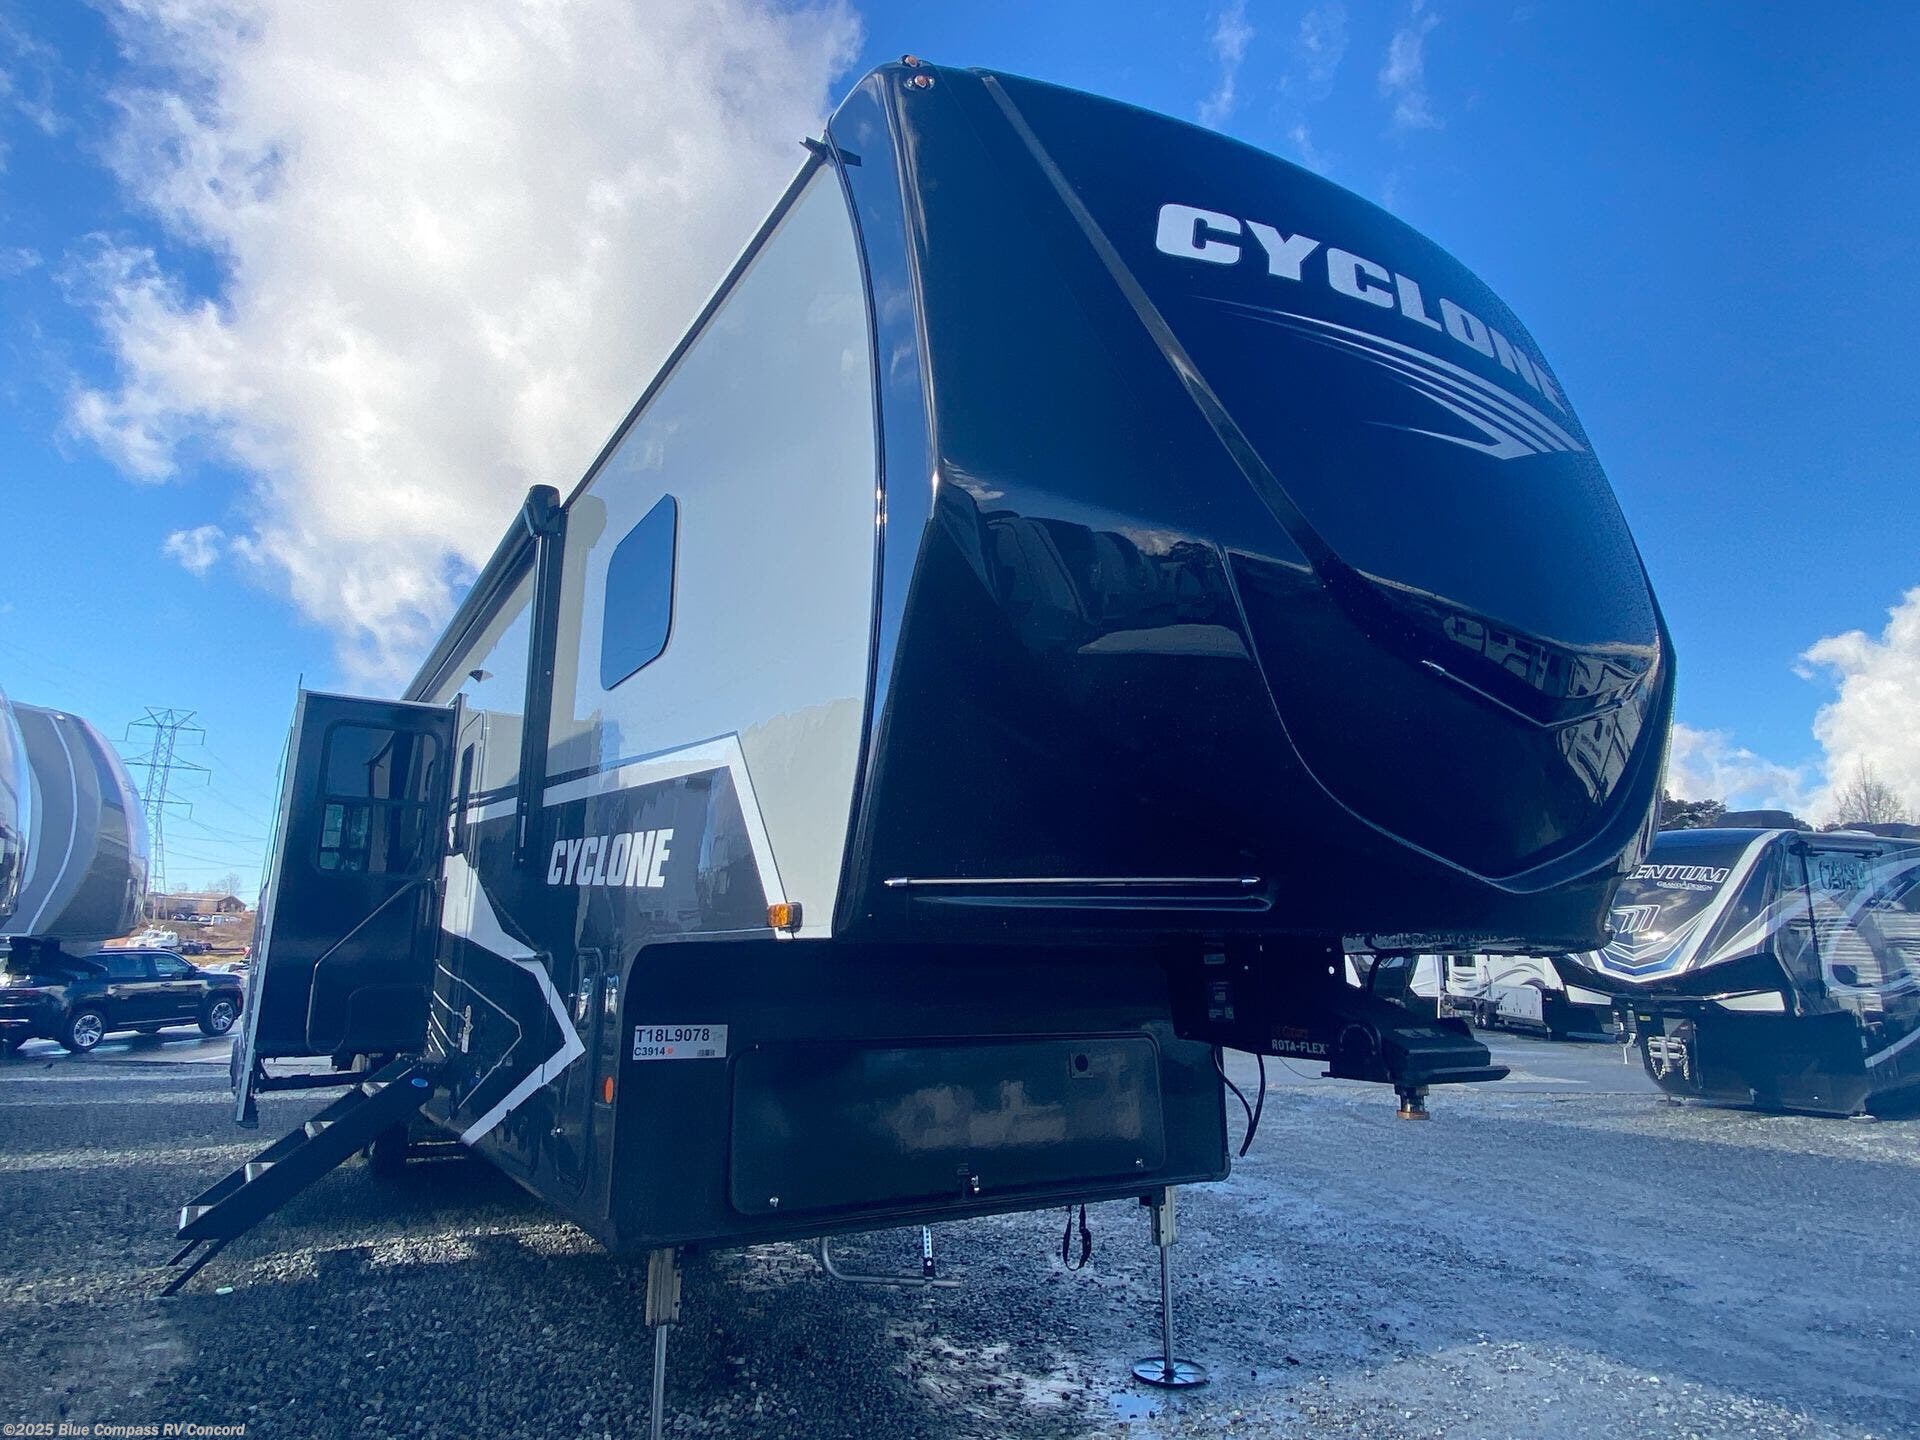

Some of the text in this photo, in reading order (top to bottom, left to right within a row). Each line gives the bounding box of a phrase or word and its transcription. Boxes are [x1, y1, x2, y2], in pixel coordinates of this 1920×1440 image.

[1156, 203, 1567, 417] CYCLONE
[547, 828, 674, 888] CYCLONE
[1627, 864, 1730, 883] ENTUM
[1656, 881, 1713, 891] GRAND DESIGN
[636, 1028, 710, 1042] T18L9078
[634, 1047, 666, 1056] C3914
